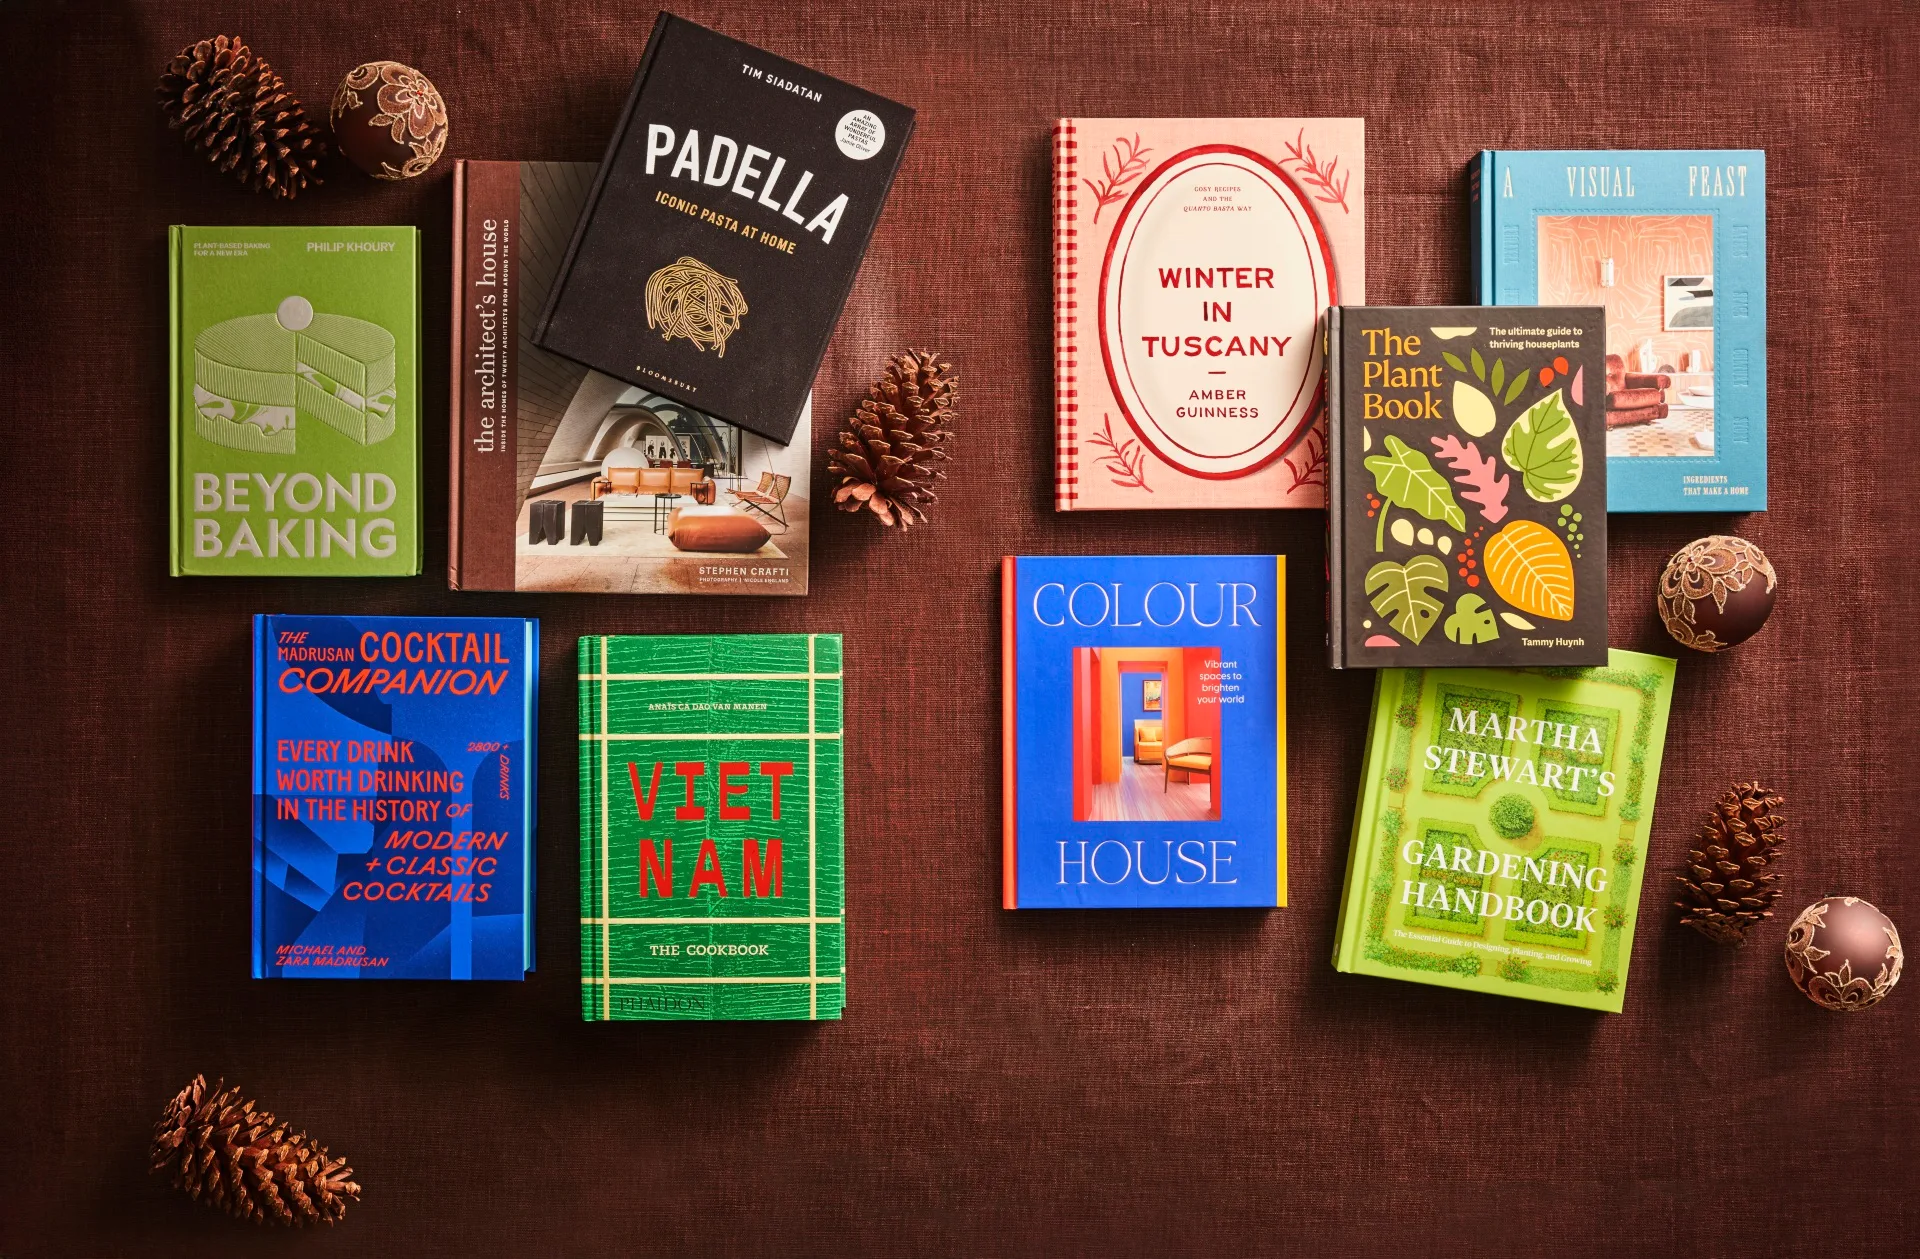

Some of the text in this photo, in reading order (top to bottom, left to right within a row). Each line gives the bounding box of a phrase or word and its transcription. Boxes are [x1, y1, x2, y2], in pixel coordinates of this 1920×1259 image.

[742, 64, 822, 102] TIM SIADATAN
[844, 124, 876, 142] WONDERFUL
[850, 122, 868, 131] ARRAY
[852, 116, 877, 130] AMAZING
[840, 138, 870, 152] Jamie Oliver
[848, 133, 868, 145] PASTAS
[645, 124, 849, 245] PADELLA
[1503, 166, 1514, 198] A
[1566, 166, 1635, 197] VISUAL
[1688, 166, 1747, 197] FEAST
[656, 190, 796, 254] ICONIC PASTA AT HOME
[306, 242, 396, 252] PHILIP KHOURY
[1158, 267, 1274, 289] WINTER
[1203, 301, 1232, 322] IN
[474, 219, 497, 453] the architect's house
[1362, 327, 1421, 356] The
[1489, 326, 1583, 338] The ultimate guide to
[1142, 336, 1292, 358] TUSCANY
[1489, 340, 1580, 350] thriving houseplants
[636, 366, 697, 392] BLOOMSBURY
[1363, 358, 1443, 388] Plant
[502, 380, 507, 389] OF
[1188, 389, 1246, 400] AMBER
[1176, 406, 1259, 418] GUINNESS
[1363, 390, 1443, 420] Book
[1684, 476, 1728, 484] INGREDIENTS
[193, 472, 397, 513] BEYOND
[1684, 486, 1748, 496] THAT MAKE A HOME
[193, 518, 397, 558] BAKING
[699, 566, 788, 576] STEPHEN CRAFTI
[1032, 582, 1262, 628] COLOUR
[278, 632, 310, 644] THE
[278, 632, 510, 664] MADRUSAN COCKTAIL
[1522, 638, 1584, 648] Tammy Huynh
[1204, 660, 1238, 668] Vibrant
[278, 668, 509, 695] COMPANION
[1200, 673, 1230, 682] spaces
[1197, 694, 1244, 704] your world
[1202, 684, 1240, 694] brighten
[648, 702, 676, 710] ANAÏS
[1446, 706, 1603, 754] MARTHA
[277, 740, 414, 763] EVERY DRINK
[467, 742, 500, 752] 2800
[276, 769, 464, 793] WORTH DRINKING
[500, 754, 510, 800] DRINKS
[1424, 745, 1616, 797] STEWART'S
[628, 762, 794, 821] VIET
[277, 798, 472, 822] IN THE HISTORY OF
[384, 831, 508, 850] MODERN
[366, 857, 497, 876] + CLASSIC
[639, 839, 783, 898] NAM
[1056, 840, 1238, 885] HOUSE
[1402, 840, 1608, 892] GARDENING
[343, 882, 492, 902] COCKTAILS
[1400, 880, 1598, 933] HANDBOOK
[276, 945, 366, 956] MICHAEL AND
[650, 945, 769, 956] THE COOKBOOK
[1393, 929, 1408, 938] The
[1408, 931, 1440, 942] Essential
[1442, 936, 1464, 946] Guide
[1473, 942, 1510, 954] Designing,
[1512, 947, 1544, 959] Planting,
[1560, 955, 1592, 966] Growing
[276, 956, 390, 966] ZARA MADRUSAN
[620, 996, 706, 1010] PHAIDON
